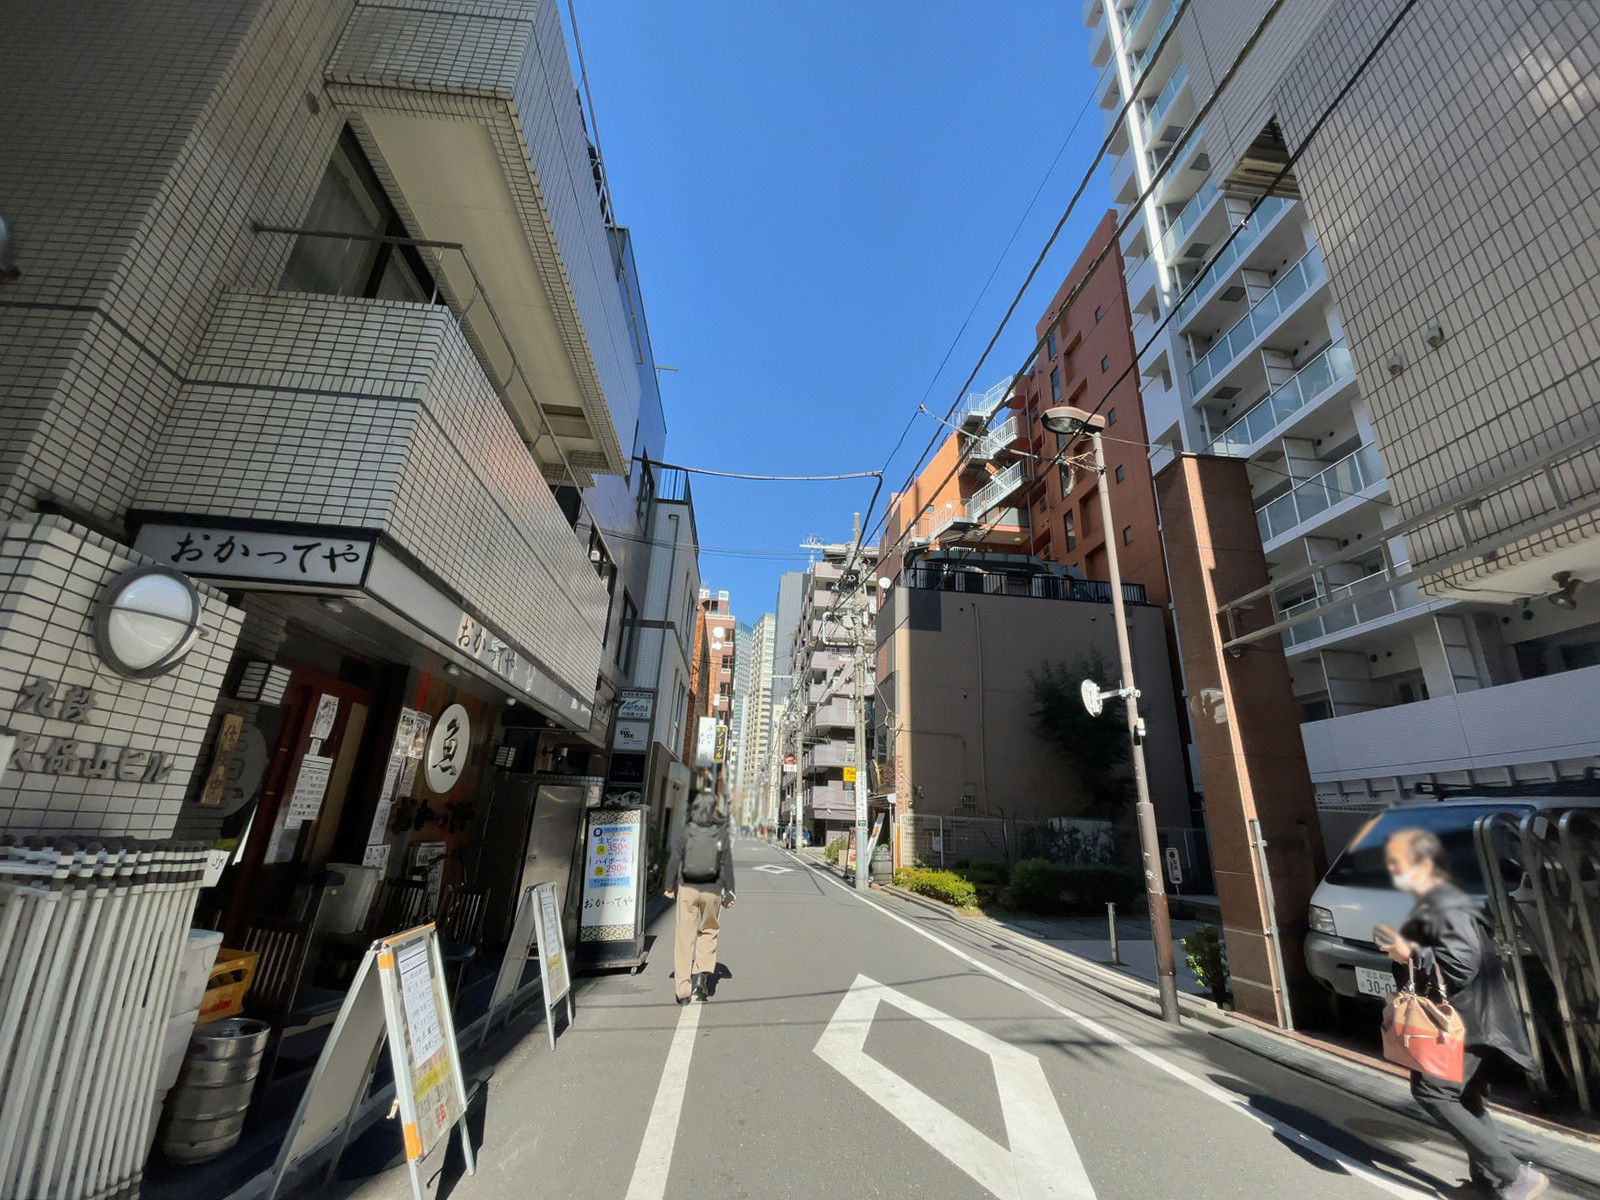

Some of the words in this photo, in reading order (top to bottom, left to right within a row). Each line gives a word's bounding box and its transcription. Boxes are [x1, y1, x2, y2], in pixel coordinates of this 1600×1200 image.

[171, 532, 360, 573] おかってや
[15, 677, 97, 724] 九段
[432, 718, 460, 776] 魚
[597, 836, 627, 844] 生ビール
[595, 857, 628, 865] ハイボール
[584, 896, 633, 909] おかってや
[1366, 978, 1398, 994] 30-0
